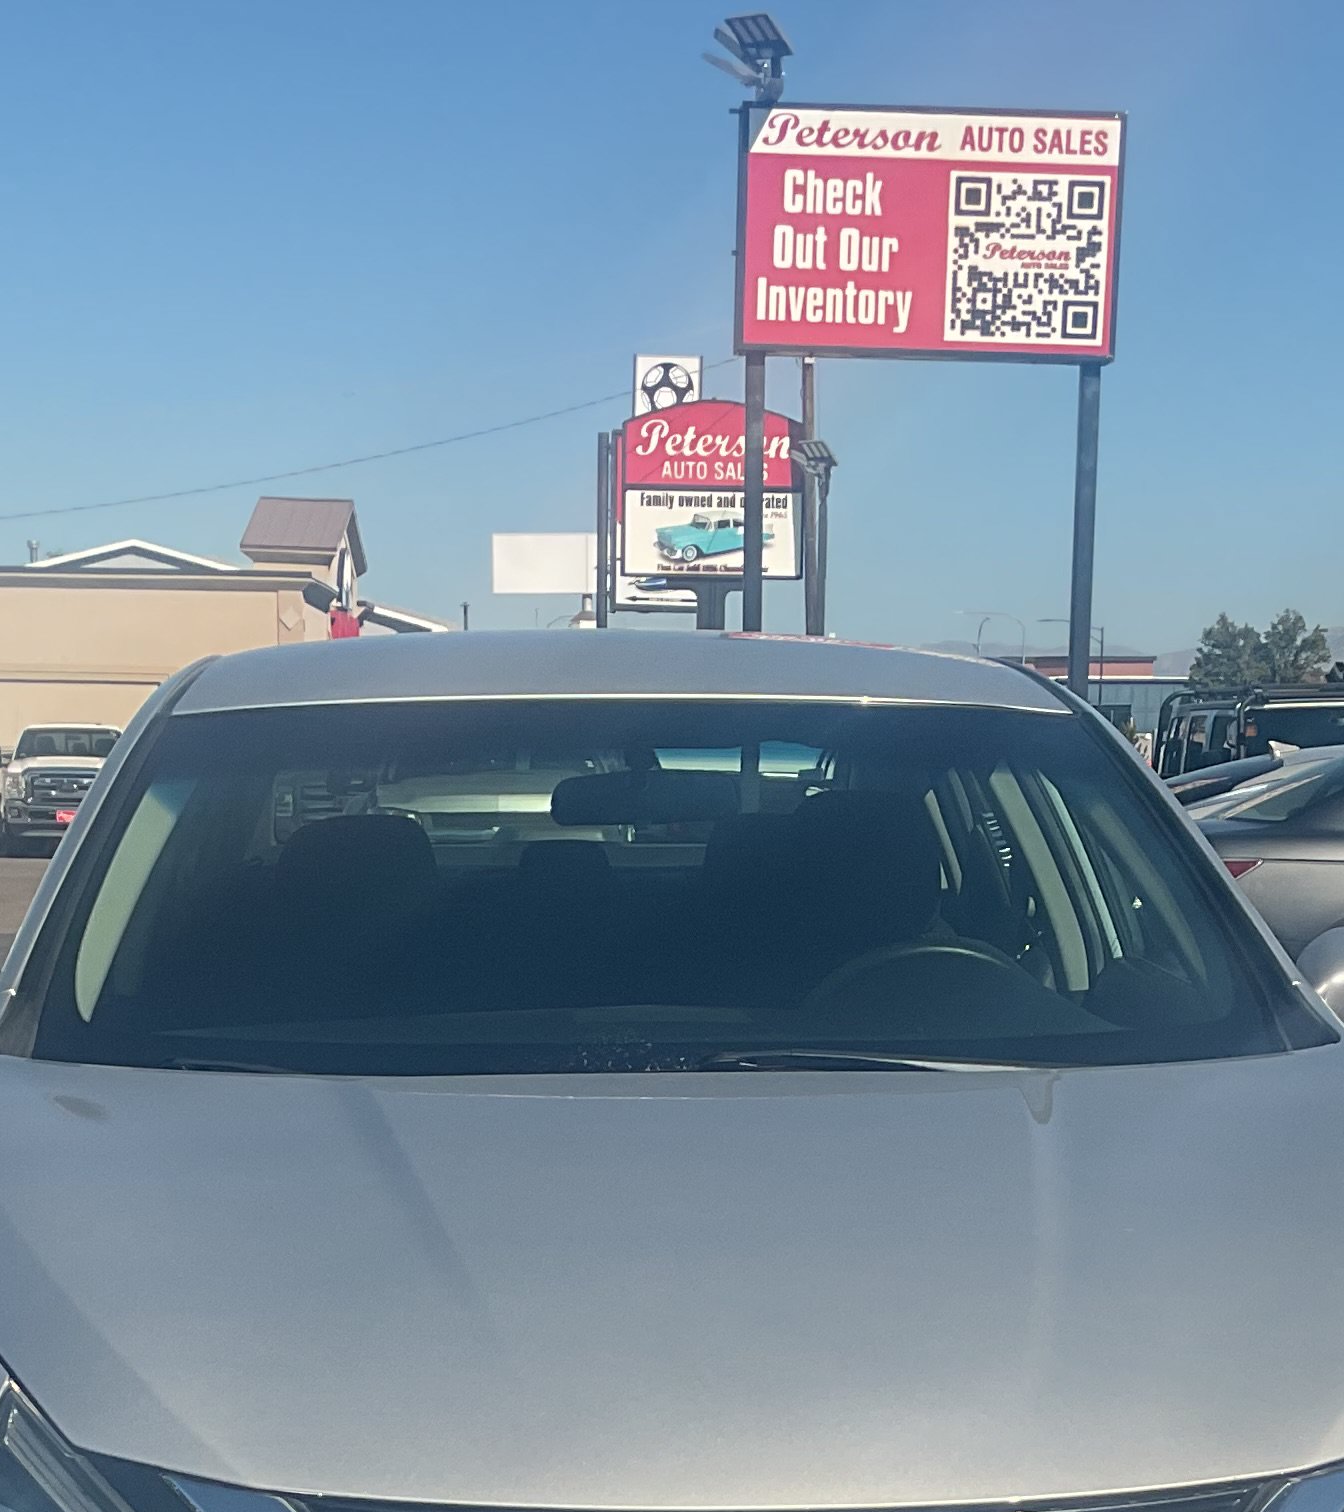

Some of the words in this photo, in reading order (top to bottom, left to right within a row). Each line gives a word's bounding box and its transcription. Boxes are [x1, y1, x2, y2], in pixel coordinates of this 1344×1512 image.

[762, 112, 942, 152] Peterson
[960, 126, 1024, 153] AUTO
[1033, 128, 1108, 156] SALES
[783, 168, 882, 216] Check
[773, 224, 827, 270] Out
[838, 227, 899, 273] Our
[982, 242, 1071, 261] Peterson
[756, 276, 912, 334] Inventory
[635, 419, 790, 459] Petersn
[662, 461, 707, 480] AUTO
[714, 461, 768, 481] SALS
[640, 491, 674, 510] Family
[678, 493, 713, 507] owned
[717, 493, 735, 508] and
[740, 493, 788, 509] oated
